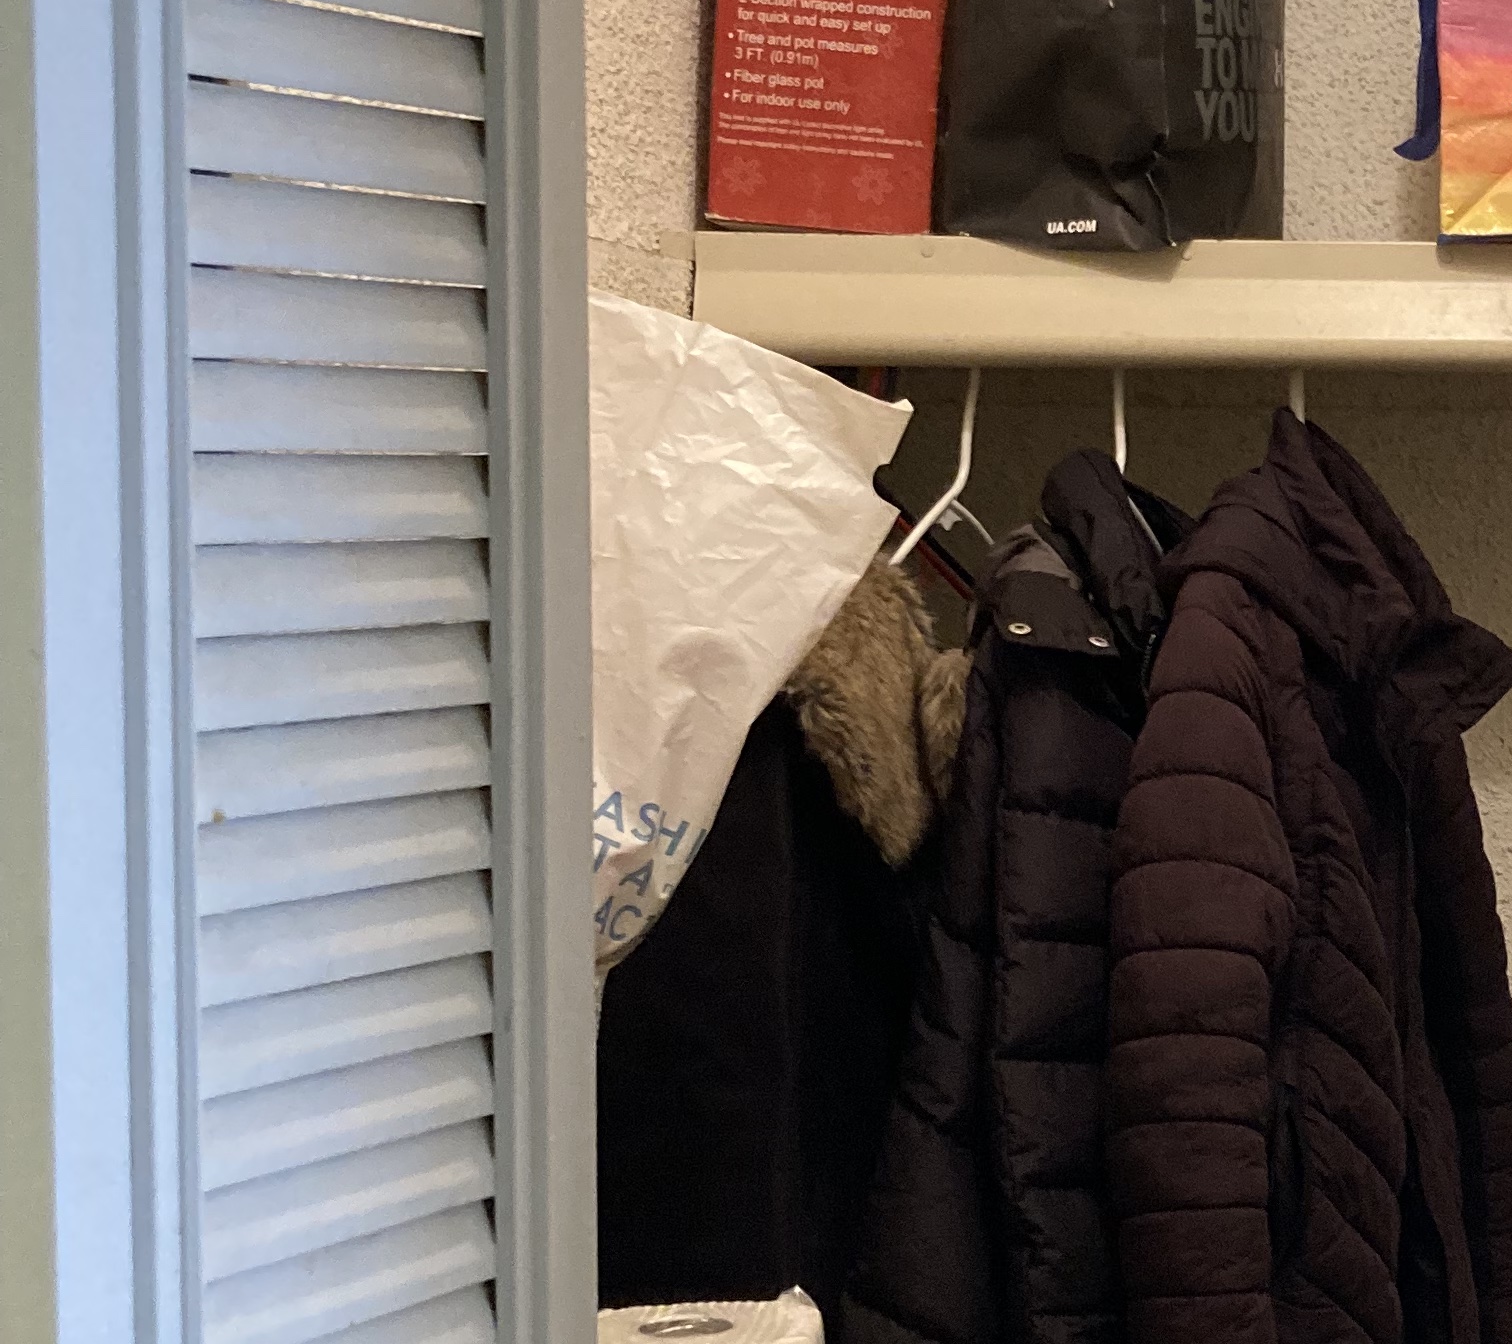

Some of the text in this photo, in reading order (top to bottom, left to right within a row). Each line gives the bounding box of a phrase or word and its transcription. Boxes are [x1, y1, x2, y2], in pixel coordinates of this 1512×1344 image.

[737, 8, 891, 35] for quick and easy set up
[856, 3, 931, 20] construction
[734, 47, 743, 59] 3
[736, 29, 879, 55] Tree and pot measures
[1195, 37, 1238, 90] TO
[733, 69, 824, 90] Fiber glass pot
[732, 89, 850, 115] For indoor use only
[1193, 89, 1258, 143] YOU
[1046, 219, 1097, 234] UA.COM
